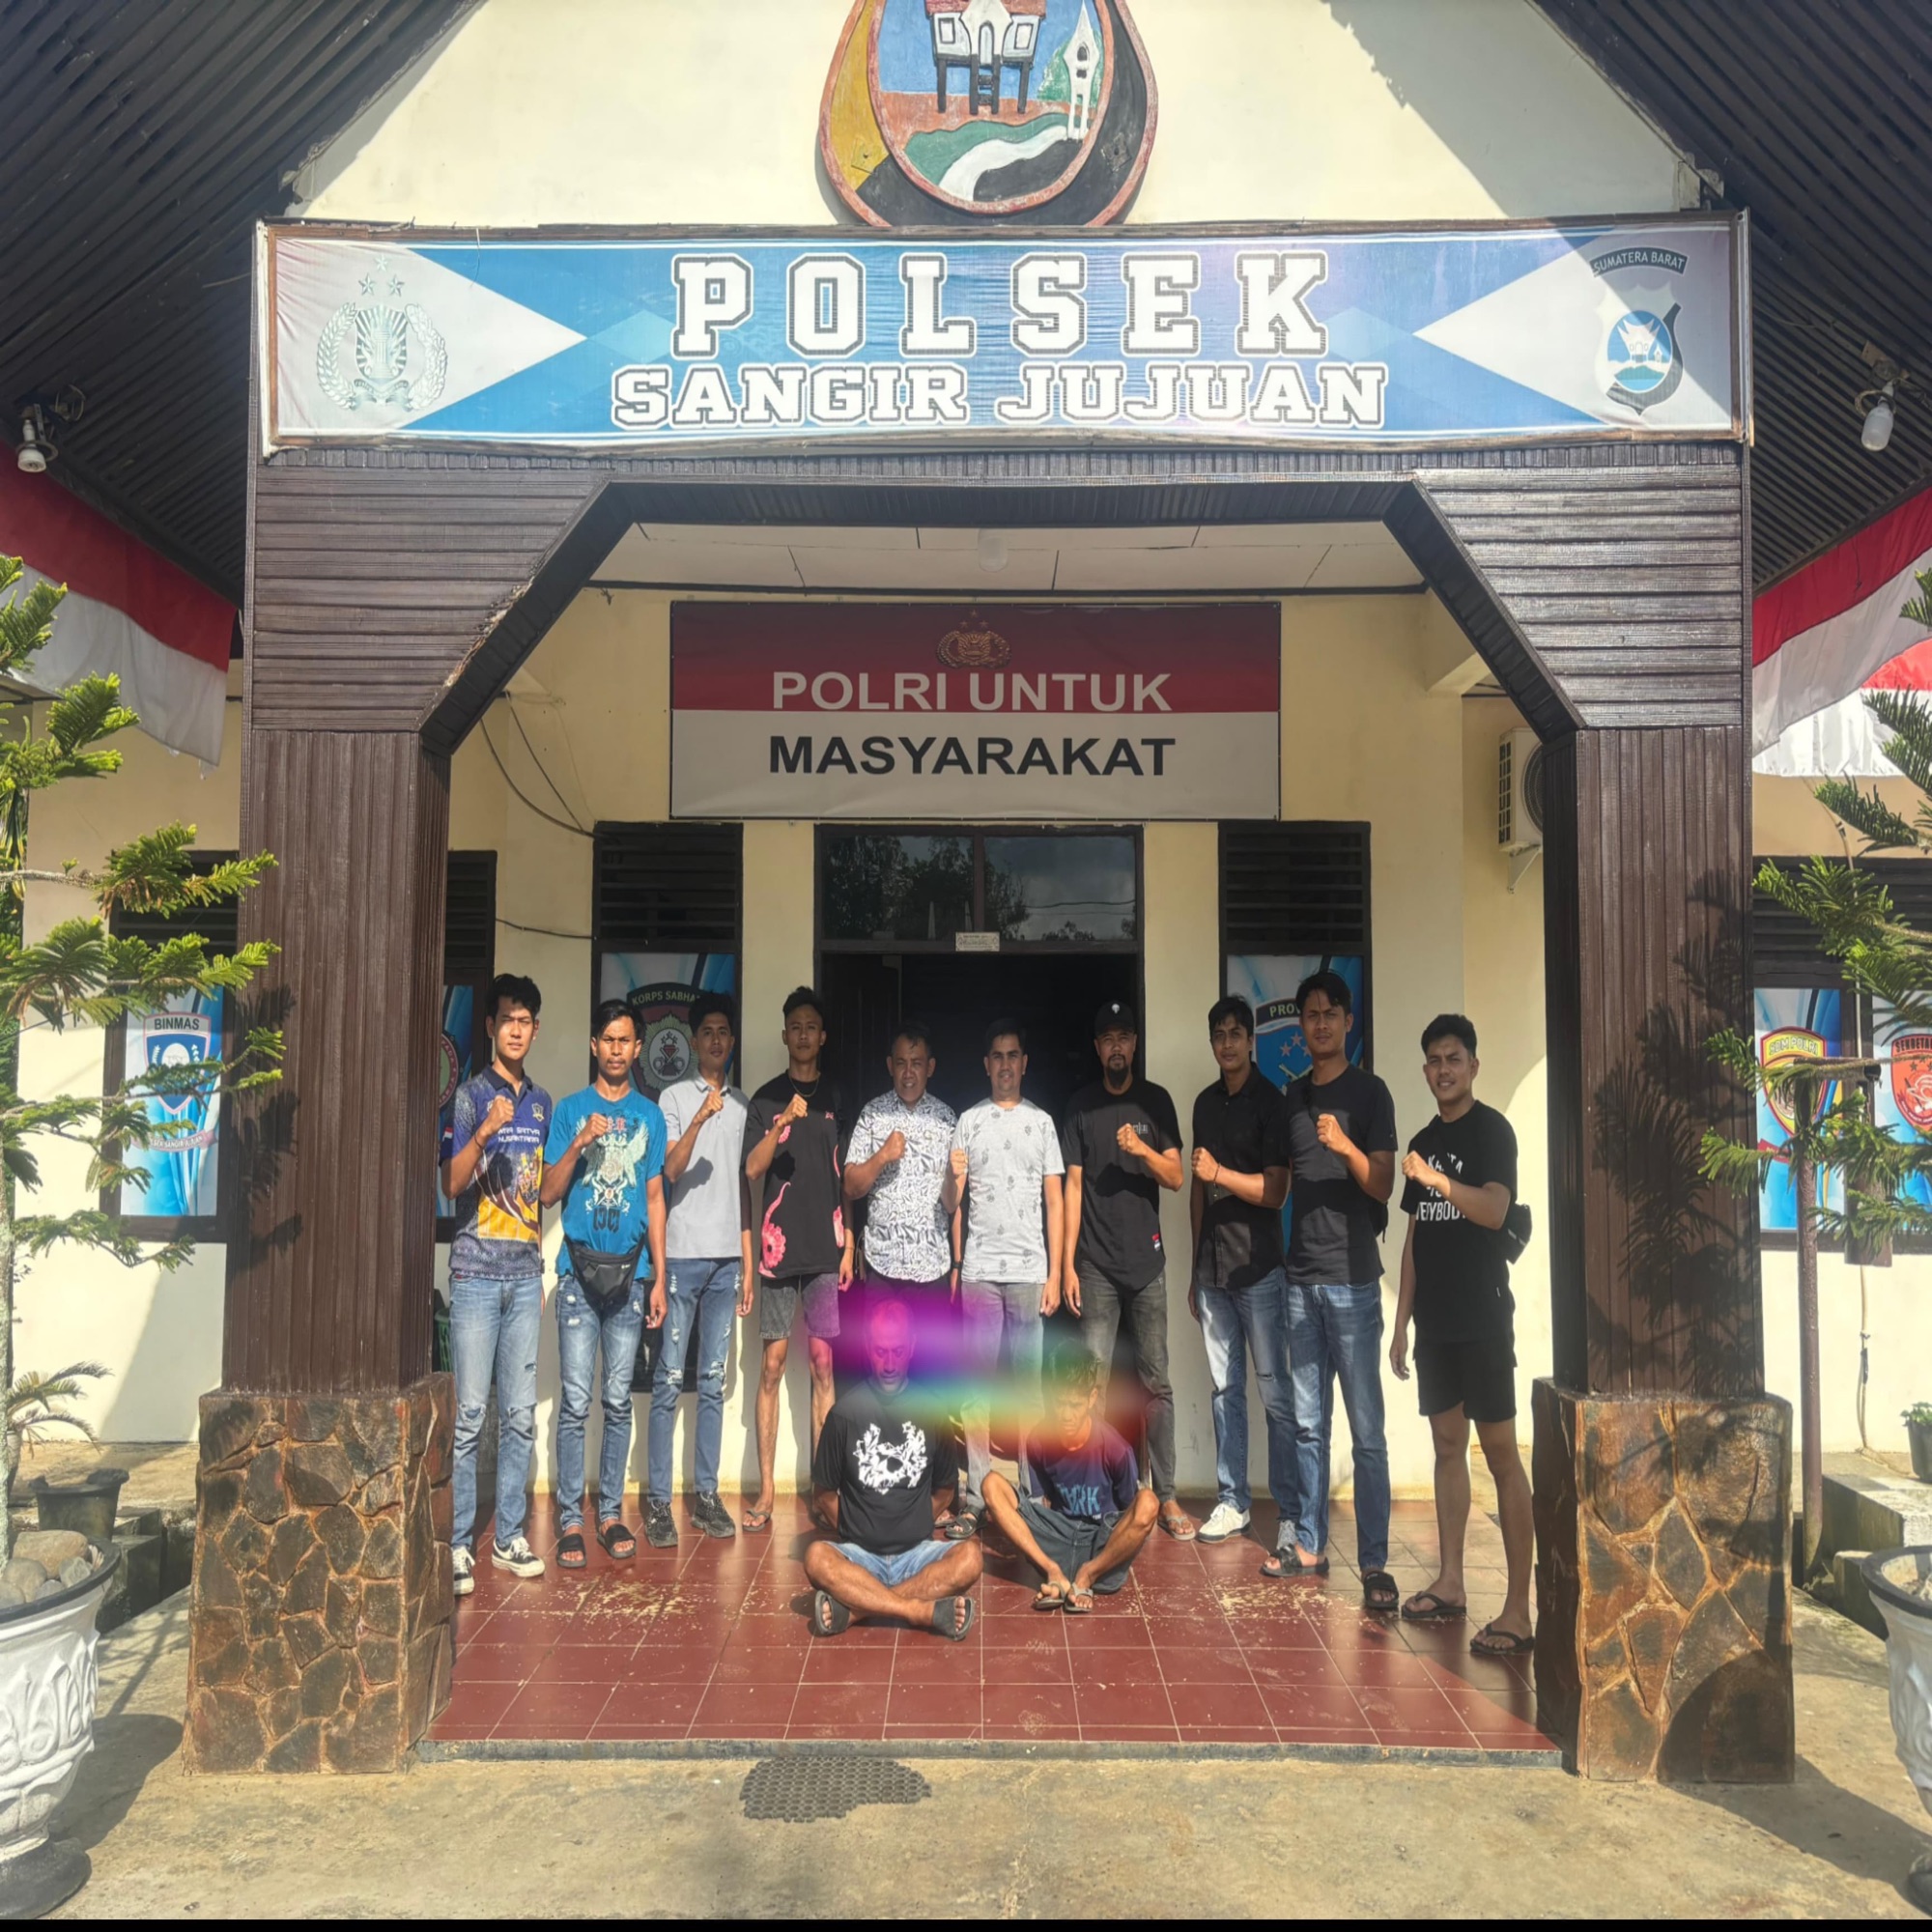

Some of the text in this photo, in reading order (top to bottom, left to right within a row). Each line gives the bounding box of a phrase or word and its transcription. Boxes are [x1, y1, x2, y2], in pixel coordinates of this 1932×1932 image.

[1594, 250, 1686, 273] SUMATERA BARAT
[611, 363, 1386, 428] SANGIR JUJUAN
[773, 670, 1172, 713] POLRI UNTUK
[770, 734, 1177, 777] MASYARAKAT
[632, 991, 663, 1006] KORPS
[154, 1017, 200, 1031] BINMAS
[1769, 1036, 1818, 1056] SDM POLRI
[1894, 1037, 1932, 1053] SEKRETA
